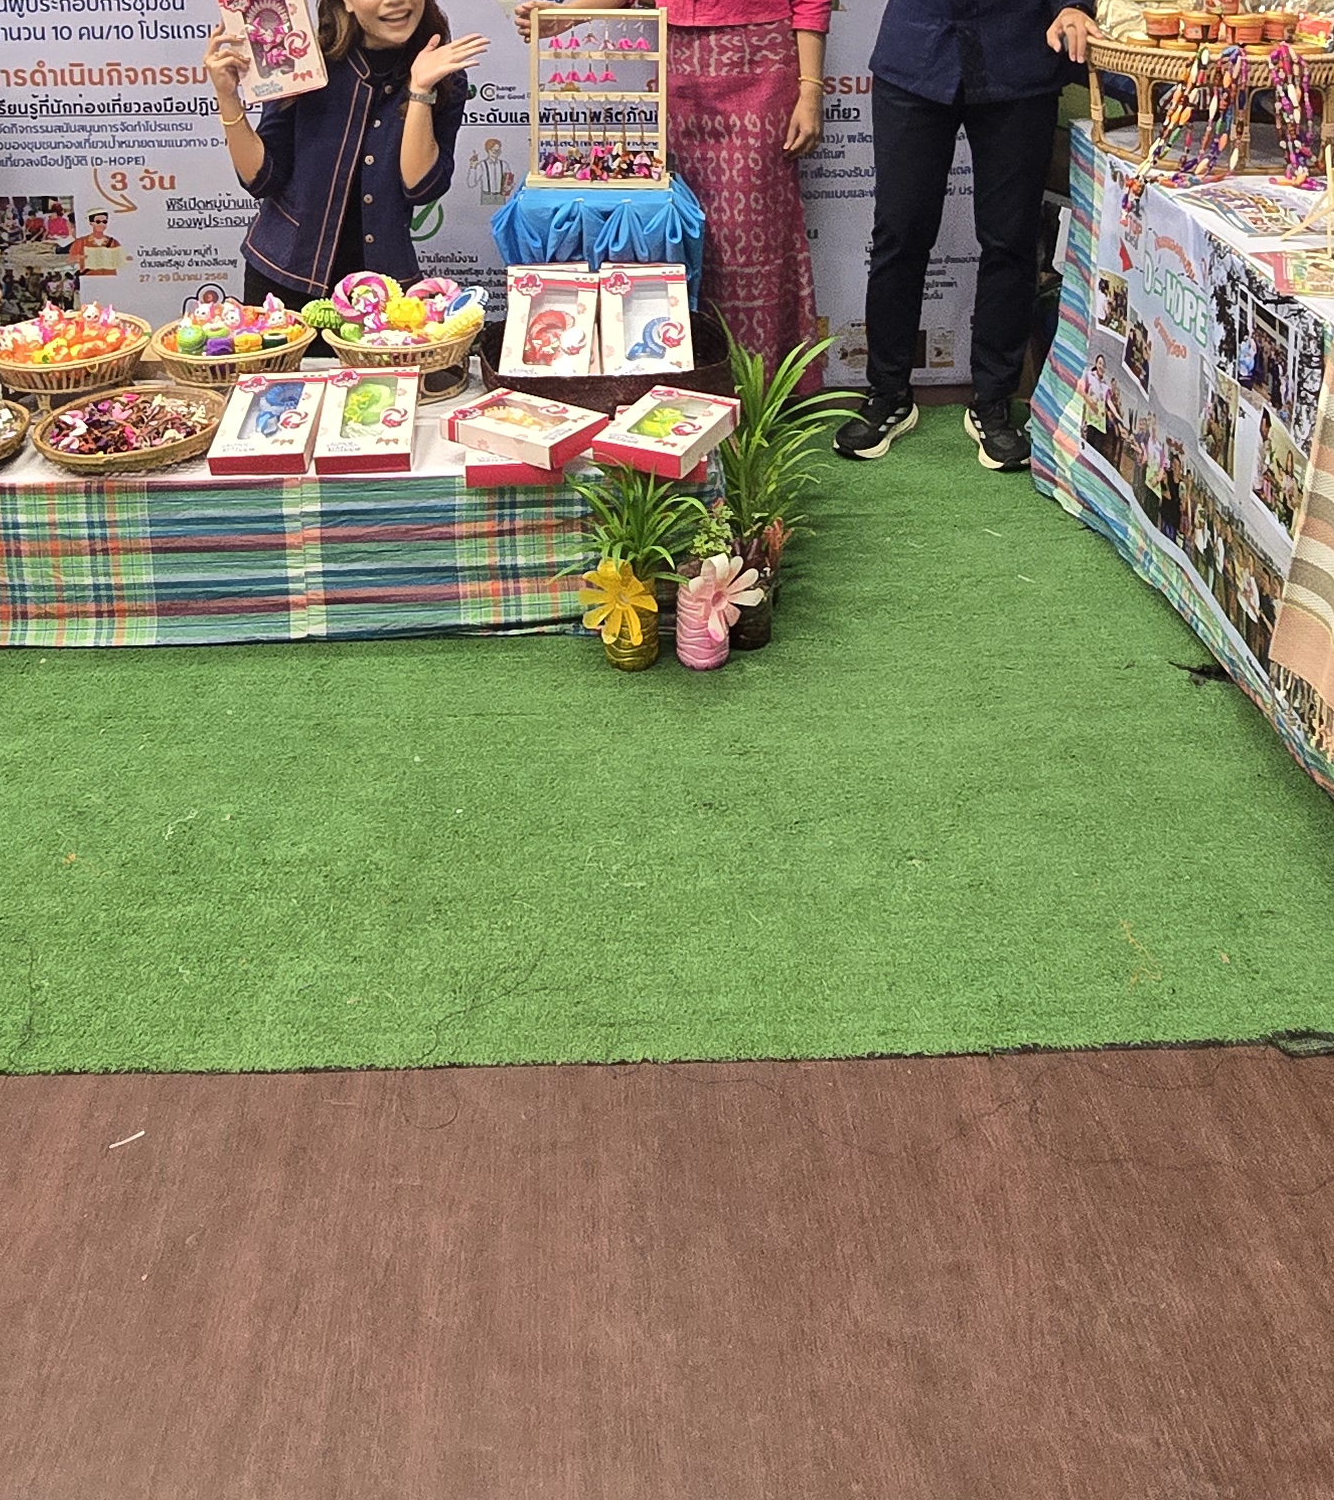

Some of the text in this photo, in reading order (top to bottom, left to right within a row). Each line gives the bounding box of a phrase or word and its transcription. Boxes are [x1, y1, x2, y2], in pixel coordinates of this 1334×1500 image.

[52, 26, 73, 42] 10
[78, 24, 135, 43] คน/10
[496, 92, 526, 101] for Good
[210, 137, 229, 149] D-
[90, 155, 146, 168] (D-HOPE)
[109, 168, 177, 192] 3 วัน
[165, 193, 263, 213] พิธีเปิดหมู่บ้านแล
[166, 211, 255, 231] ของผู้ประกอบ
[139, 274, 151, 283] 27
[1142, 250, 1209, 348] D-HOPE
